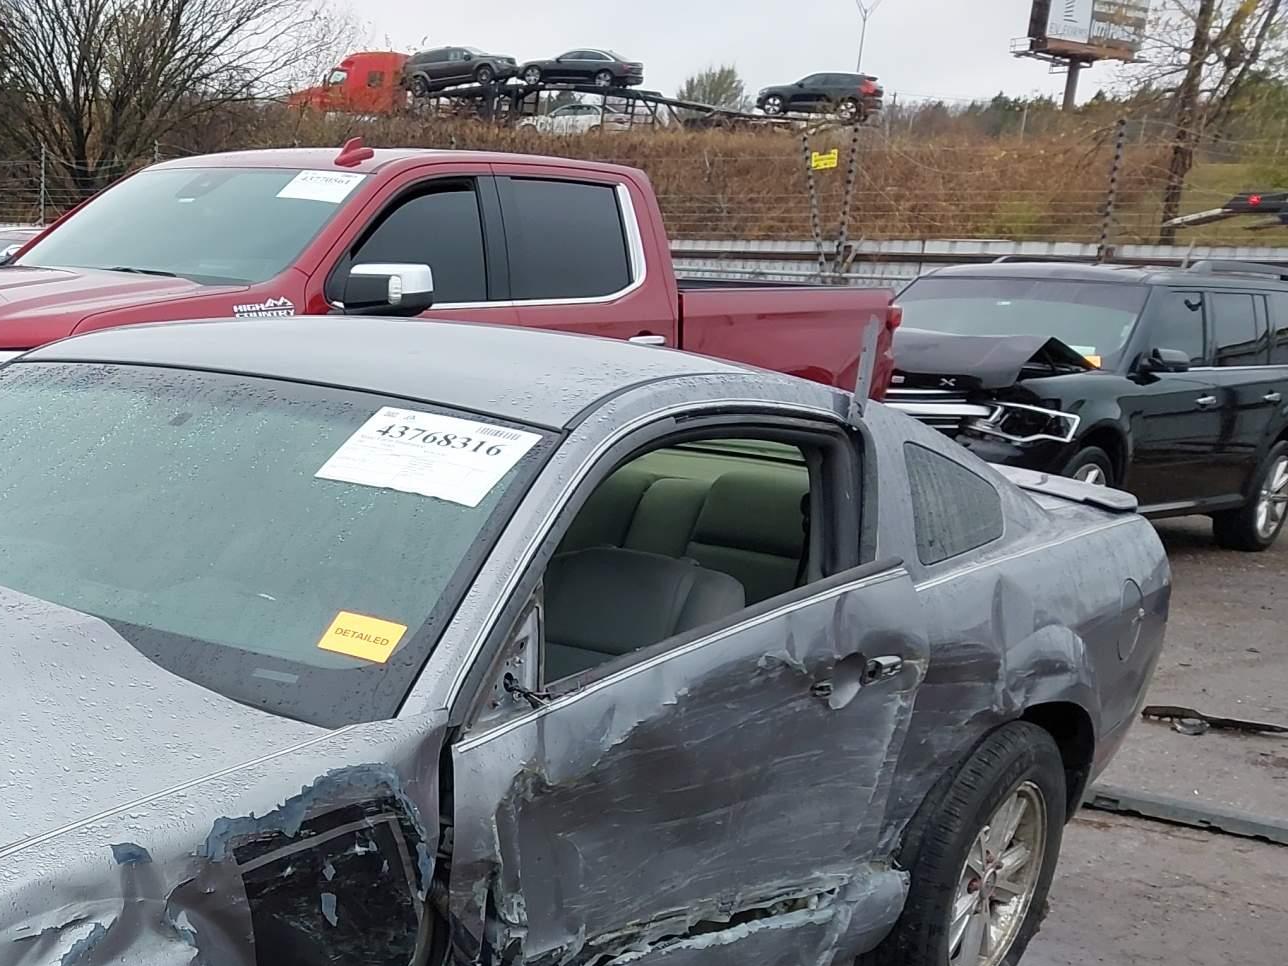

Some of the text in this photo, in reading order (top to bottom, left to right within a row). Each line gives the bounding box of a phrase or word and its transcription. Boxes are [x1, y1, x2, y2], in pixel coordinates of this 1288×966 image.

[233, 304, 265, 312] HIGH
[235, 309, 295, 318] COUNTRY
[376, 424, 508, 456] 43768316
[334, 627, 390, 646] DETAILED
